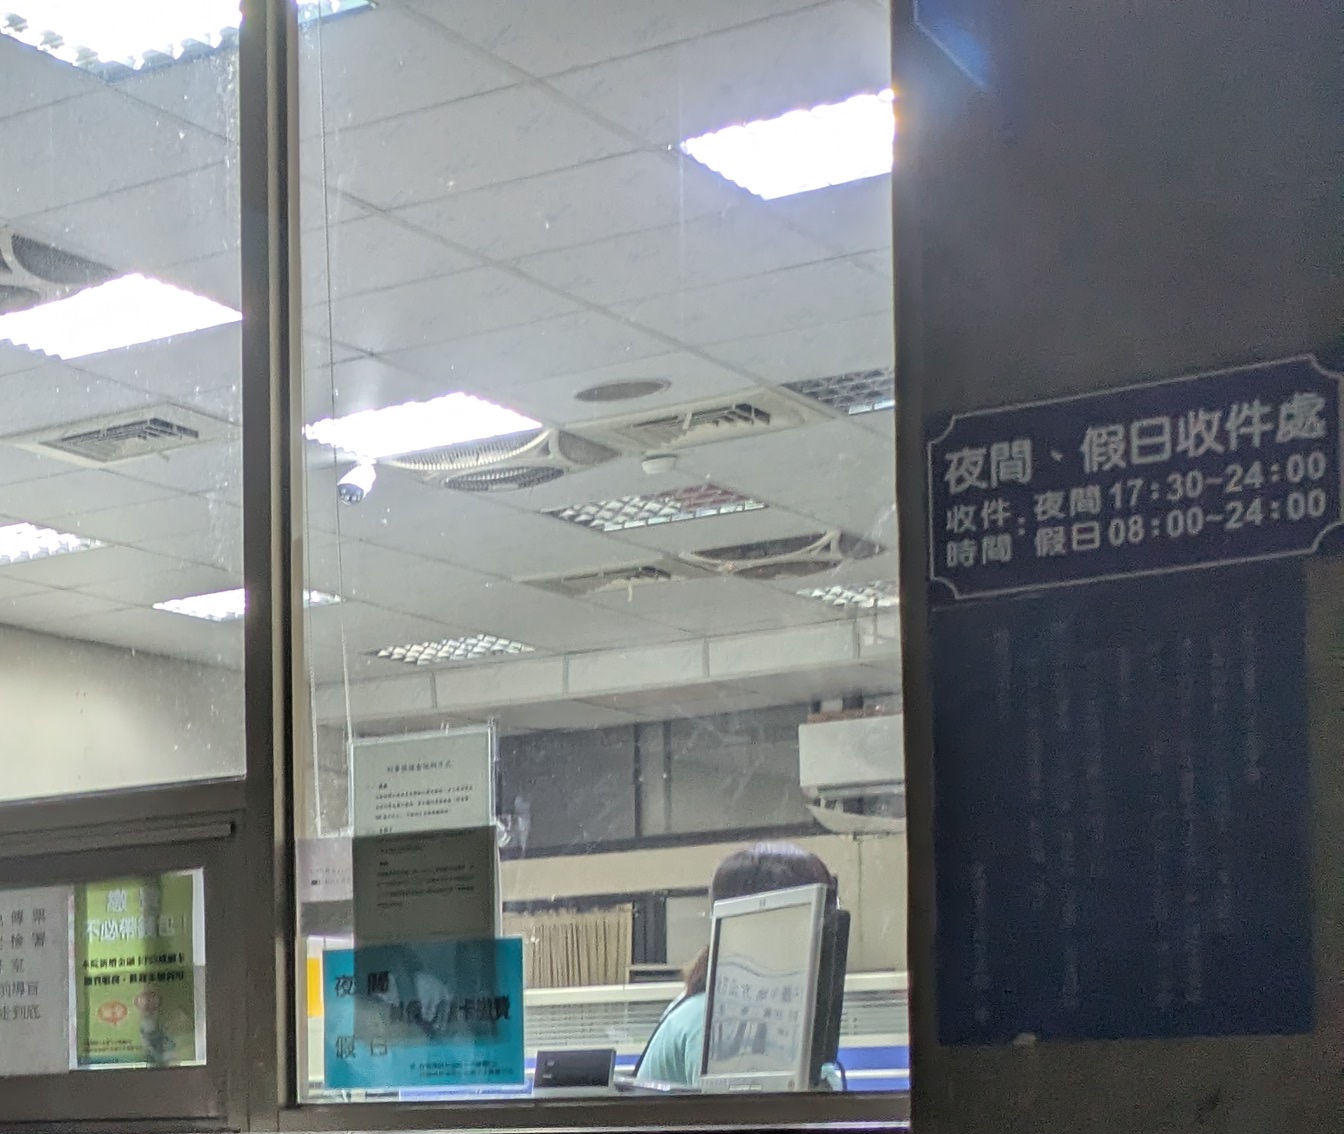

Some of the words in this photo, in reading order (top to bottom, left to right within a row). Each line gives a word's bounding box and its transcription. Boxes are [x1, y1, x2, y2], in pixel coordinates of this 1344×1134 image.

[944, 391, 1327, 495] 夜間、假日收件處
